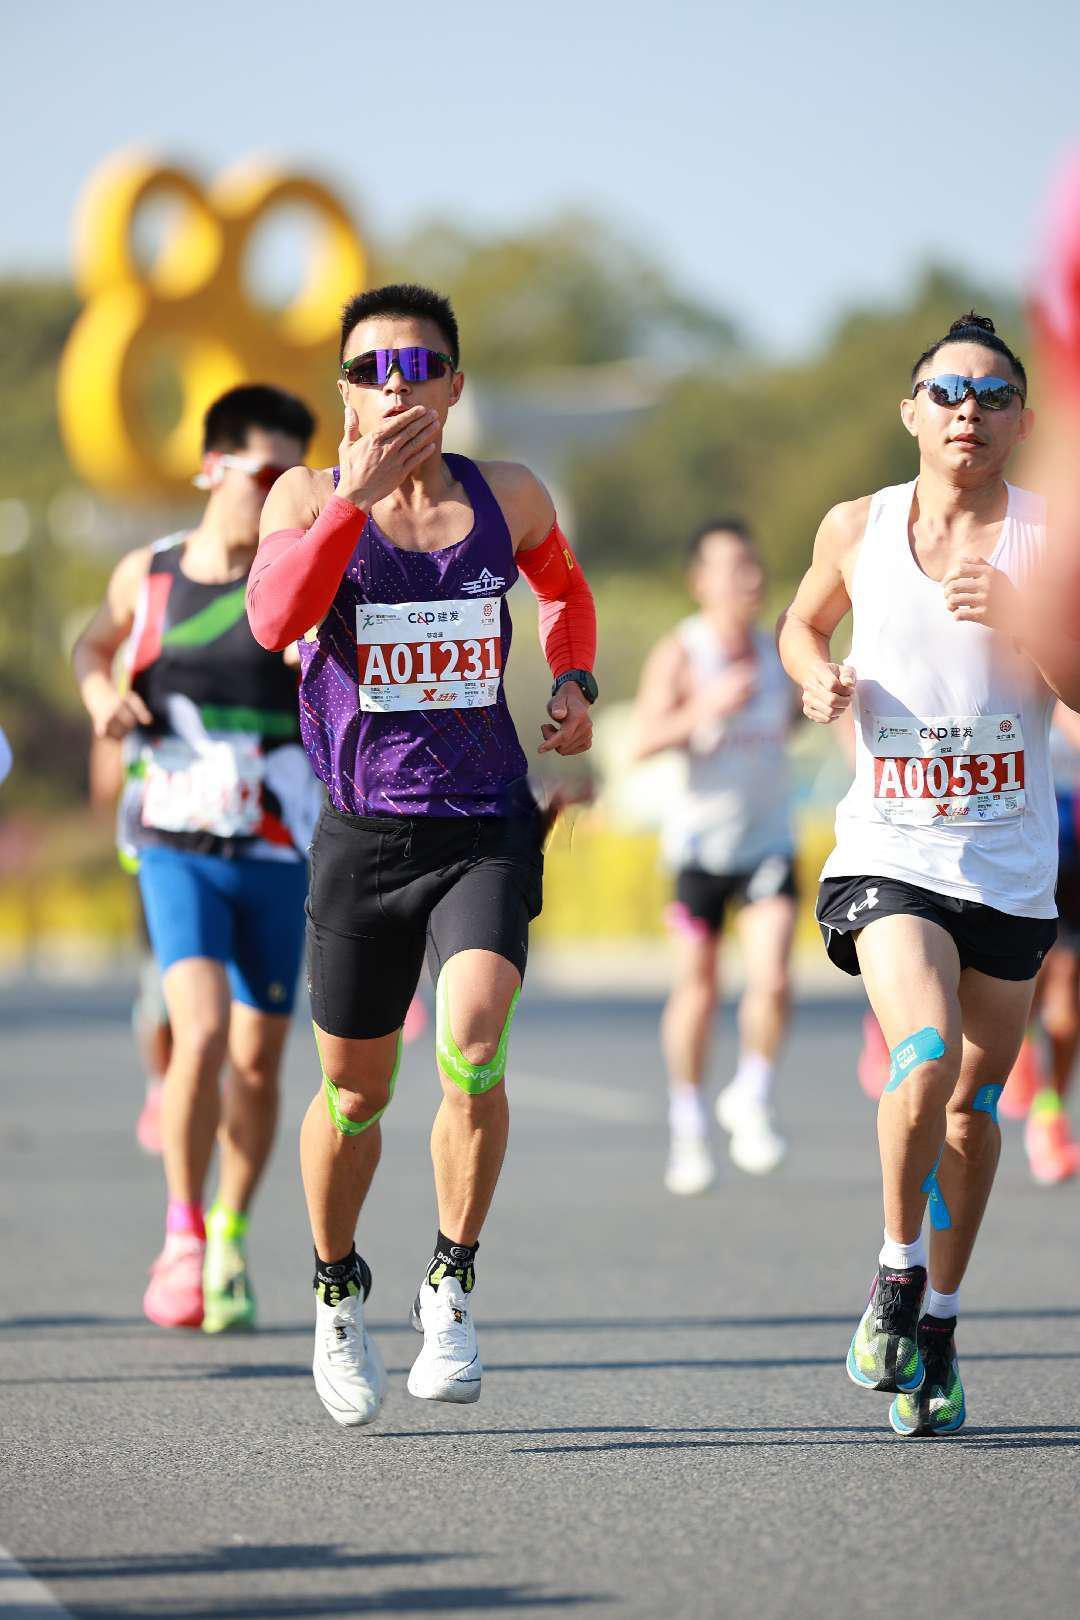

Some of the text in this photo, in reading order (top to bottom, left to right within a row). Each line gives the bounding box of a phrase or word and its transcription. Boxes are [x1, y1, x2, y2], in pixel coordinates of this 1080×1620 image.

[408, 612, 435, 625] C&D
[363, 638, 500, 685] A01231
[919, 727, 948, 741] C&D
[950, 726, 974, 738] 建发
[879, 754, 1021, 798] A00531
